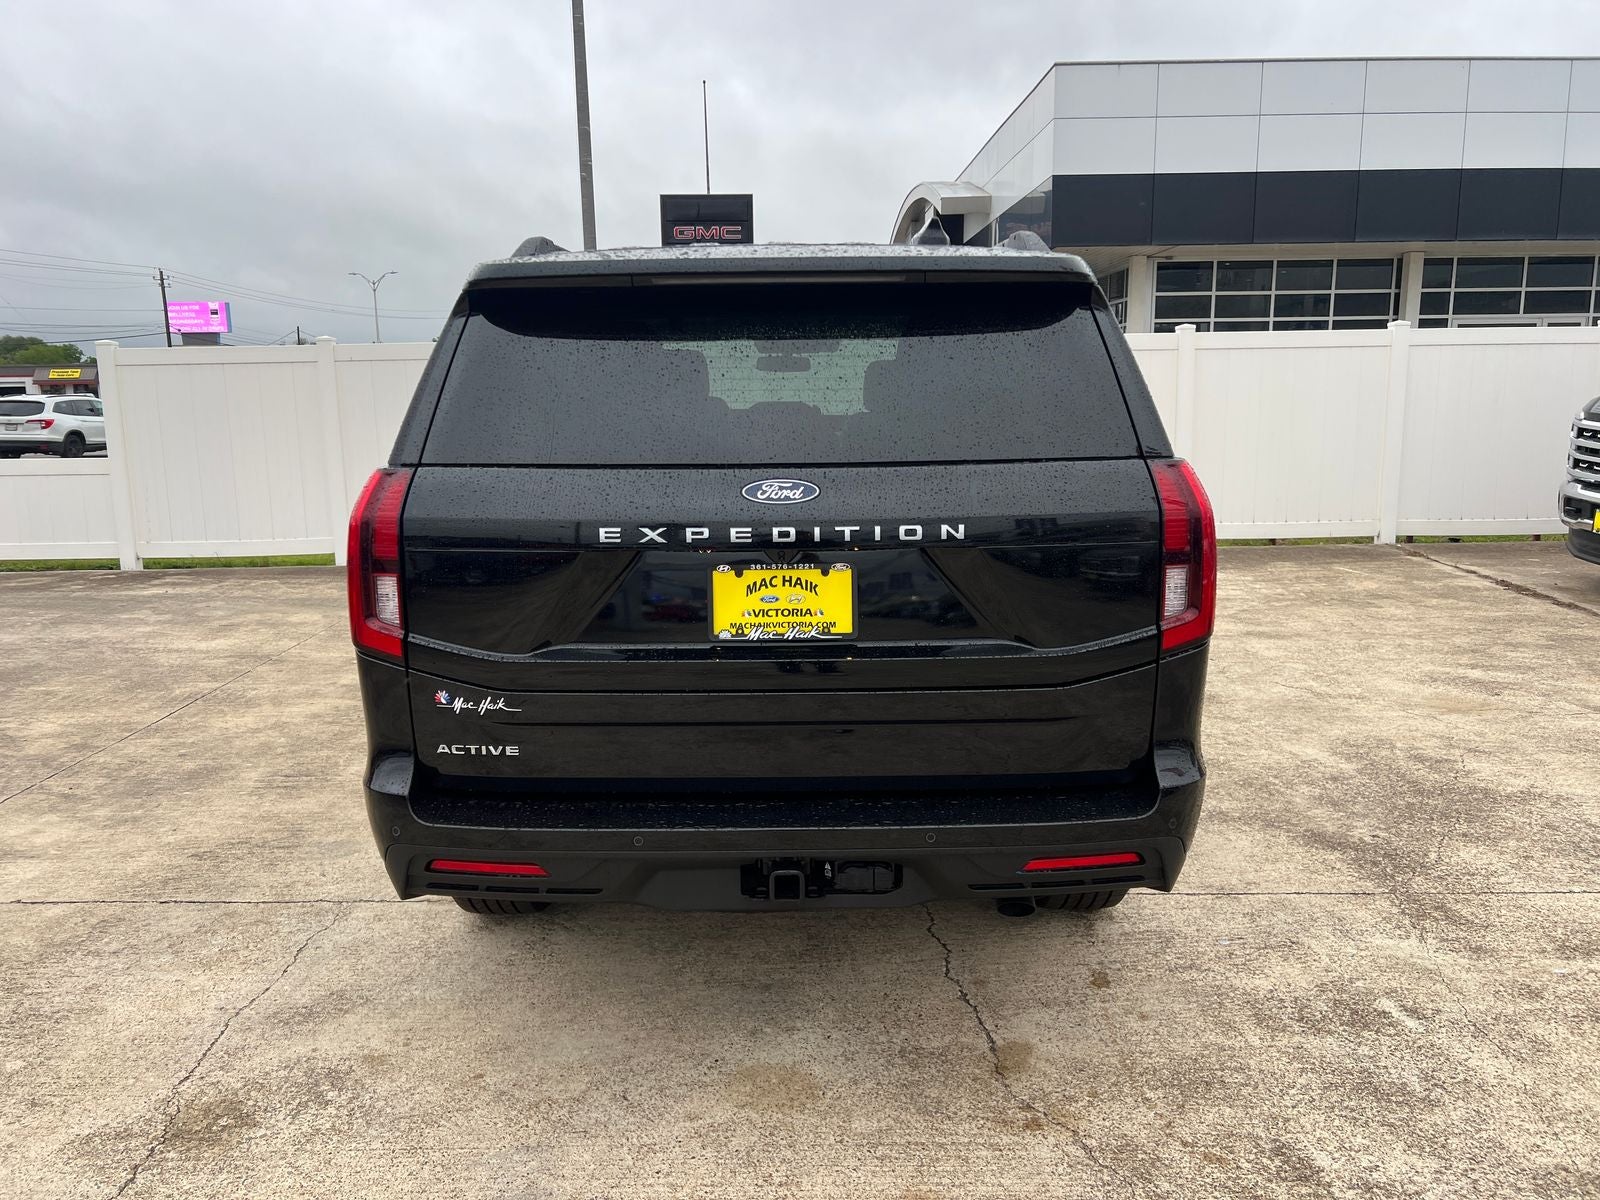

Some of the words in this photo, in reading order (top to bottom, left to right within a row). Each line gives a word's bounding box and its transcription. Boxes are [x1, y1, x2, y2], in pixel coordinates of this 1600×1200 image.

[674, 226, 741, 239] GMC
[757, 482, 804, 499] Ford
[599, 524, 965, 543] EXPEDITION
[746, 575, 778, 597] MAC
[782, 575, 819, 596] HAIK
[752, 608, 813, 617] VICTORIA
[729, 621, 837, 629] MACHAIKVICTORIA.COM
[745, 626, 783, 640] Mac
[783, 626, 825, 640] Haik
[450, 697, 477, 714] Mac
[478, 696, 510, 715] Haik
[436, 744, 519, 756] ACTIVE
